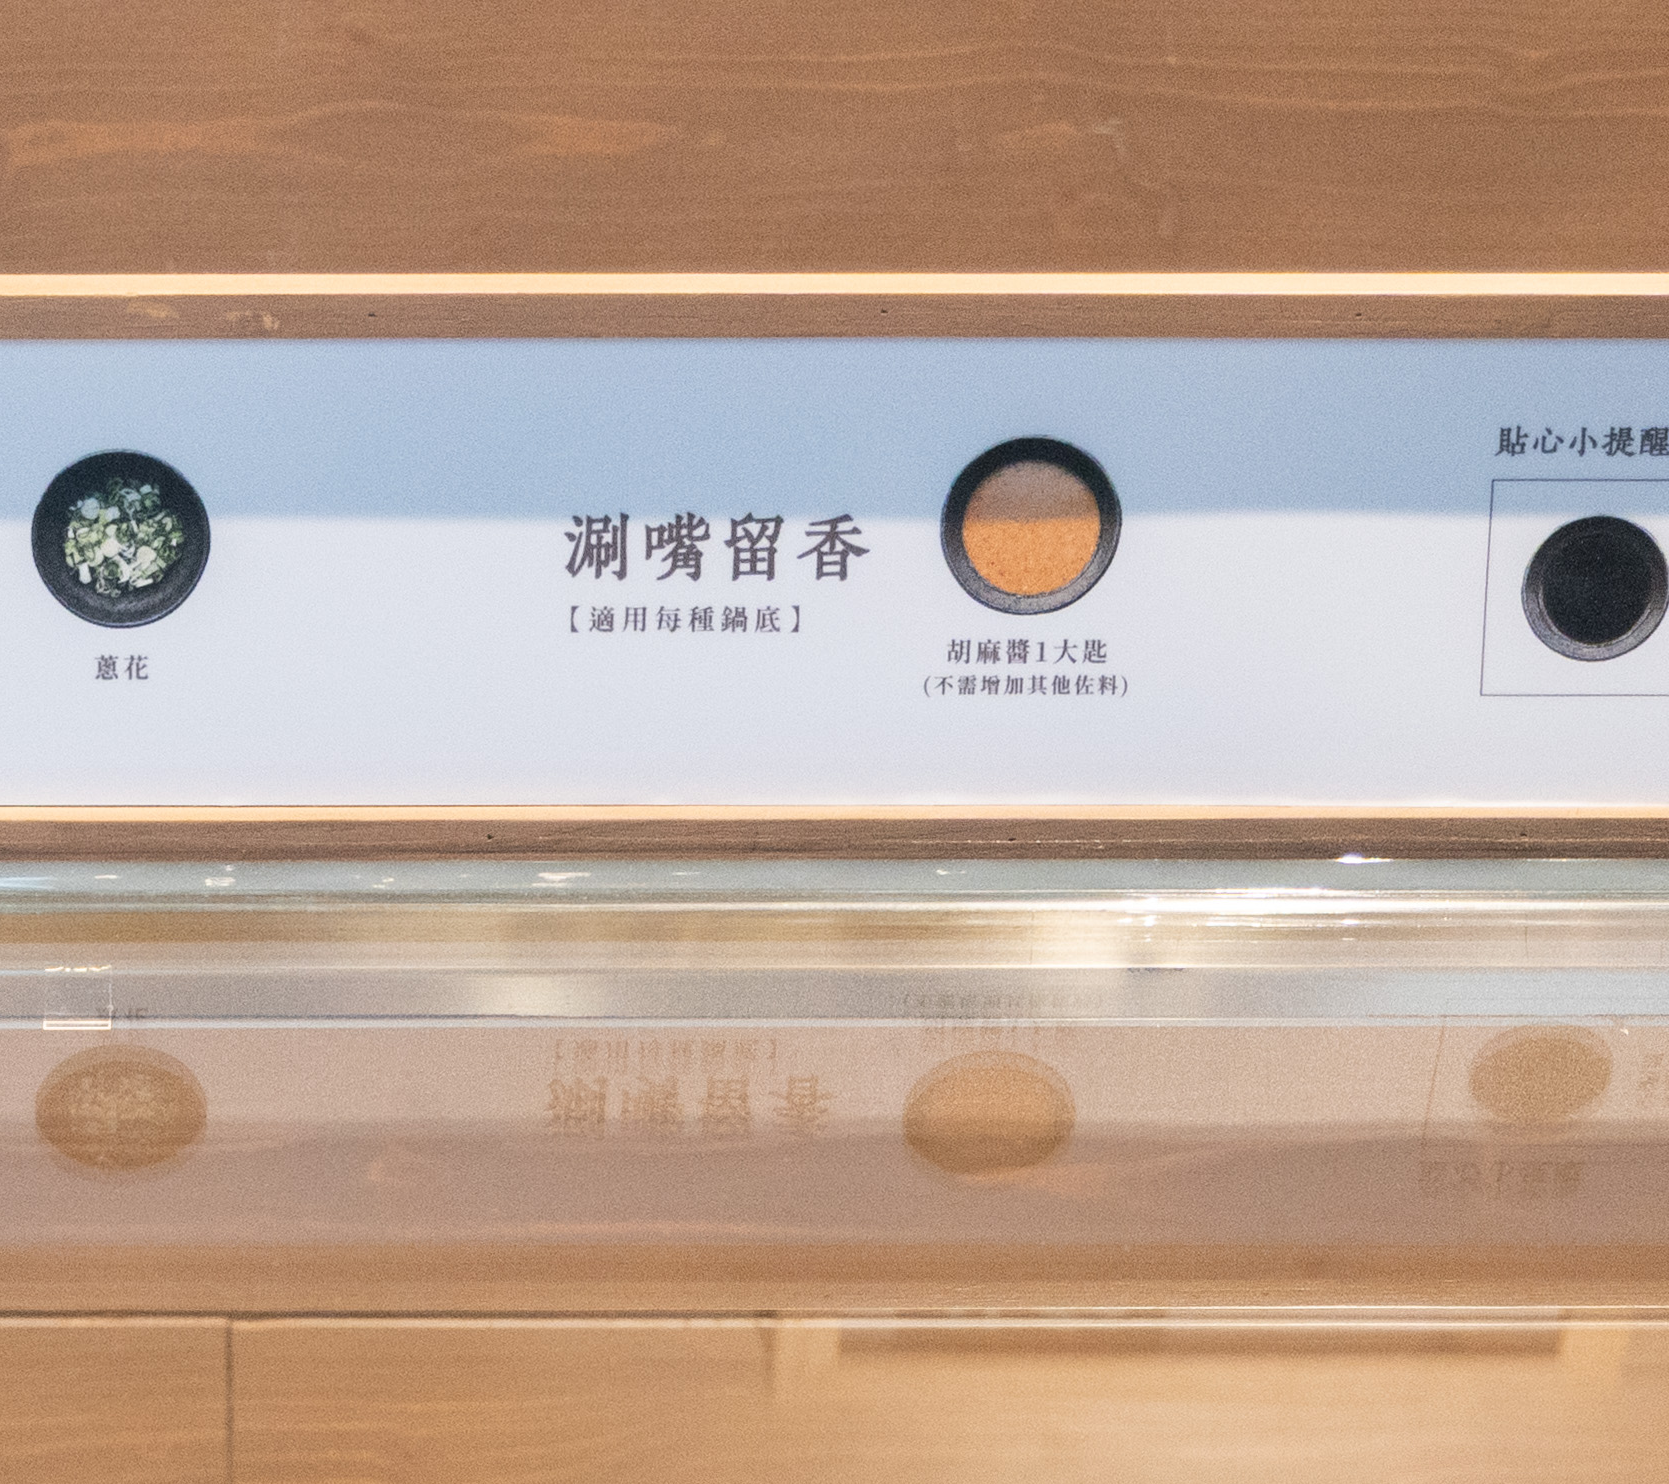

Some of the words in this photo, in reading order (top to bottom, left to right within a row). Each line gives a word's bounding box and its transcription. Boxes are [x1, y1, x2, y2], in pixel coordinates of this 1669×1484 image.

[564, 511, 870, 582] 涮嘴留香
[947, 637, 1108, 665] 胡麻醬1大匙
